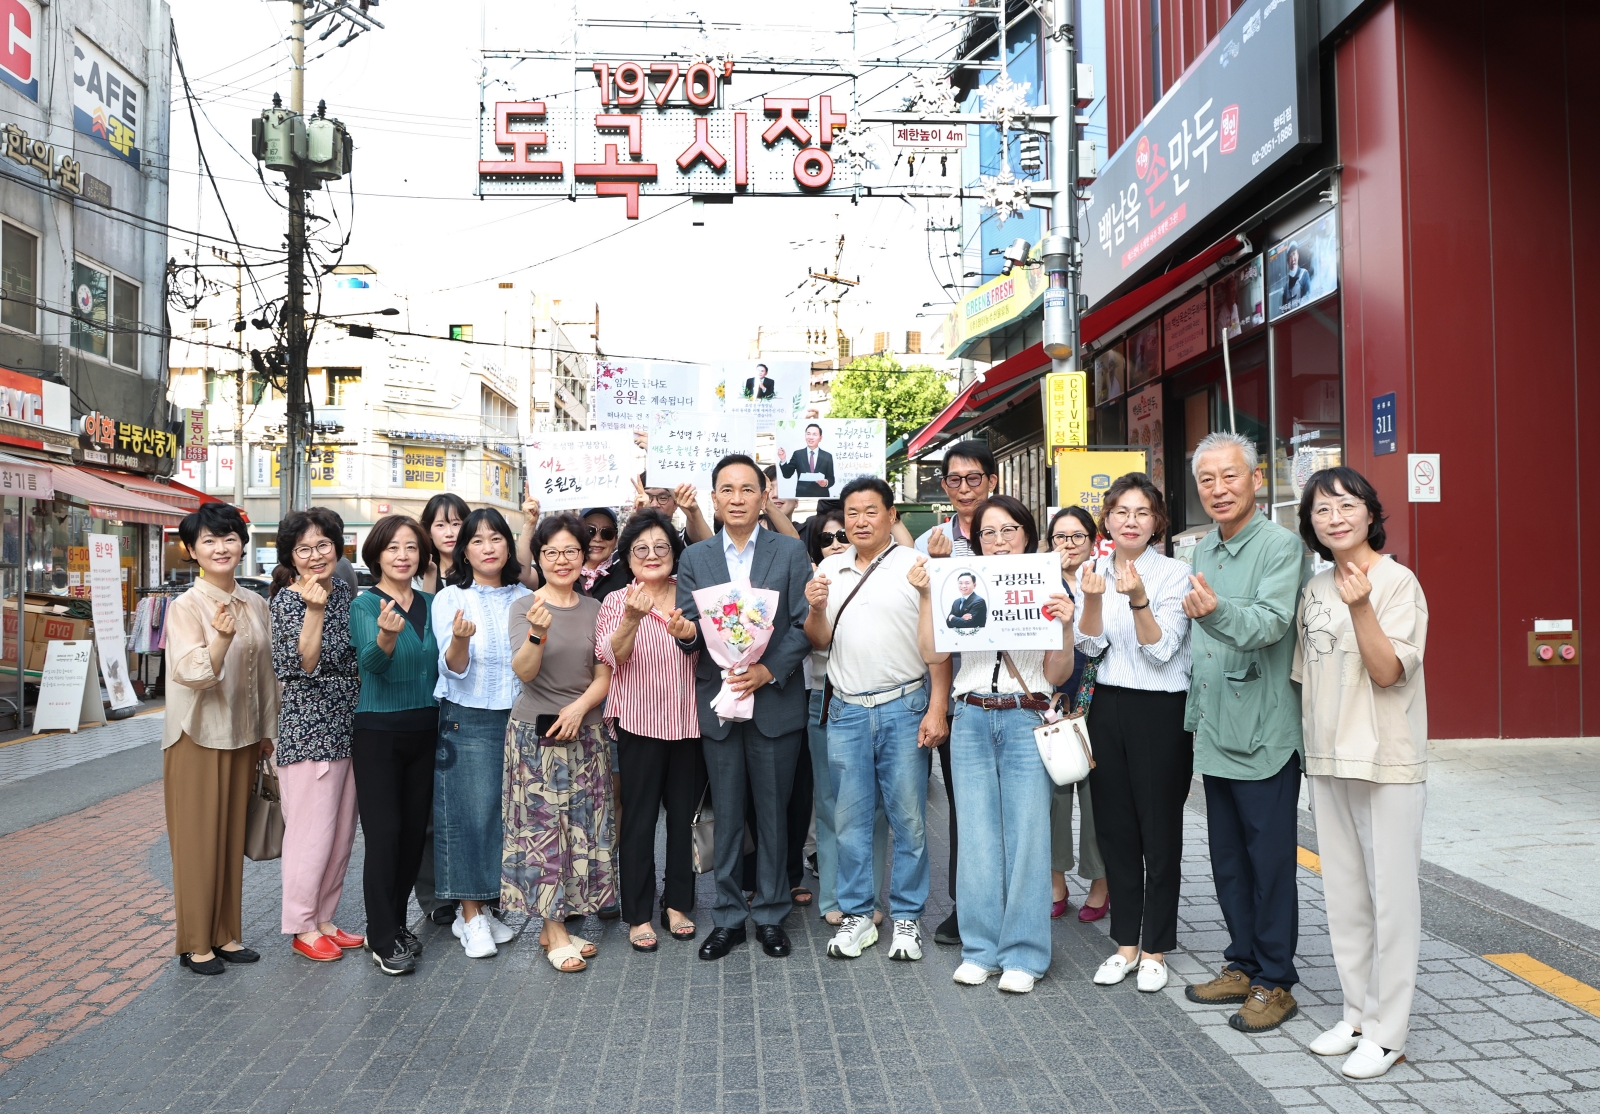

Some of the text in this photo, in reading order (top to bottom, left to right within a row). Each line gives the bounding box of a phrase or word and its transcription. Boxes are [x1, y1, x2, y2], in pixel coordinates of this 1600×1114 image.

[74, 45, 136, 126] CAFE
[109, 114, 135, 157] 3F
[897, 130, 963, 142] 제한높이 4m
[7, 123, 80, 194] 한의원
[479, 95, 847, 218] 도곡시장
[1098, 97, 1219, 257] 백남옥 손만두
[615, 378, 639, 388] 임기는
[613, 390, 694, 407] 응원은 계속됩니다
[1069, 378, 1080, 452] CCTV단속
[191, 410, 204, 446] 부동산
[1376, 415, 1392, 434] 311
[86, 411, 176, 458] 이화 부동산중개
[669, 430, 692, 440] 조성명
[857, 441, 869, 450] 수고
[115, 453, 138, 468] 568-0033
[405, 453, 444, 467] 어지럼증
[583, 453, 618, 473] 출발을
[3, 470, 36, 491] 참기름
[405, 470, 444, 483] 알레르기
[544, 475, 619, 494] 응원합니다!
[95, 542, 113, 558] 한약
[991, 573, 1045, 586] 구청장님,
[1004, 590, 1035, 605] 최고
[48, 623, 70, 638] BYC
